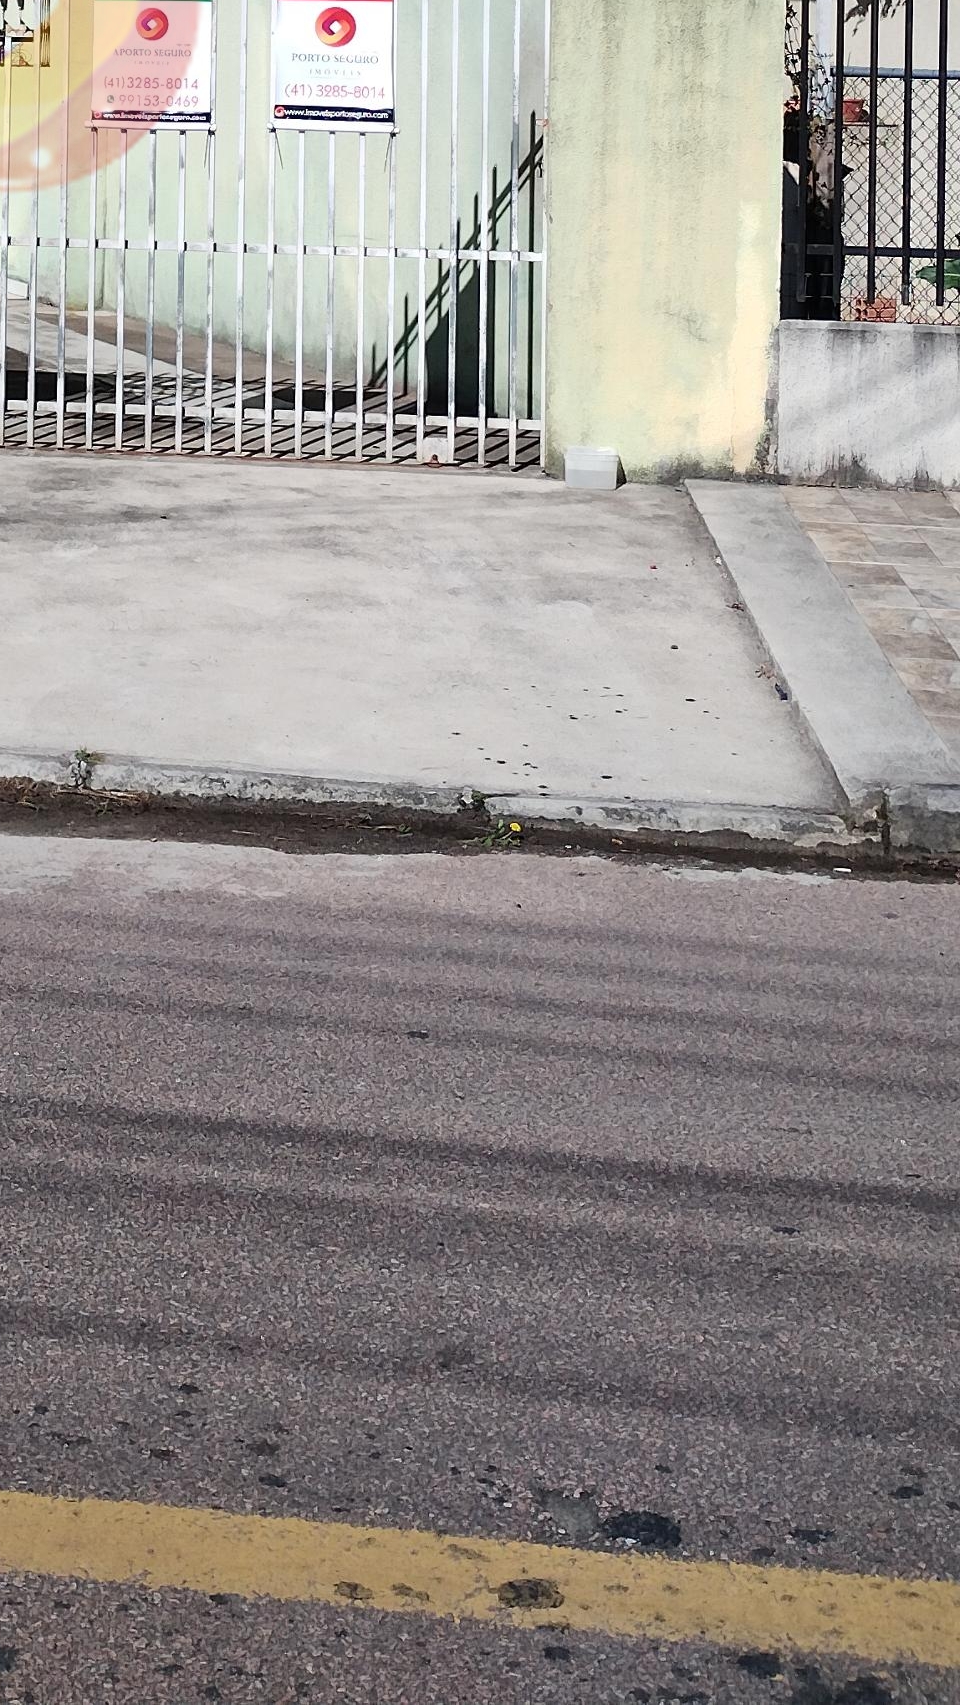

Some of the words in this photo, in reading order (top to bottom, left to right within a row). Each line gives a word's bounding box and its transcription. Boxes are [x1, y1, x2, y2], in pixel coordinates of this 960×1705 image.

[155, 49, 192, 58] SEGURO
[292, 53, 331, 63] PORTO
[334, 54, 379, 64] SEGURO
[284, 84, 313, 98] (41)
[316, 84, 385, 99] 3285-8014
[119, 94, 199, 107] 99153-0469
